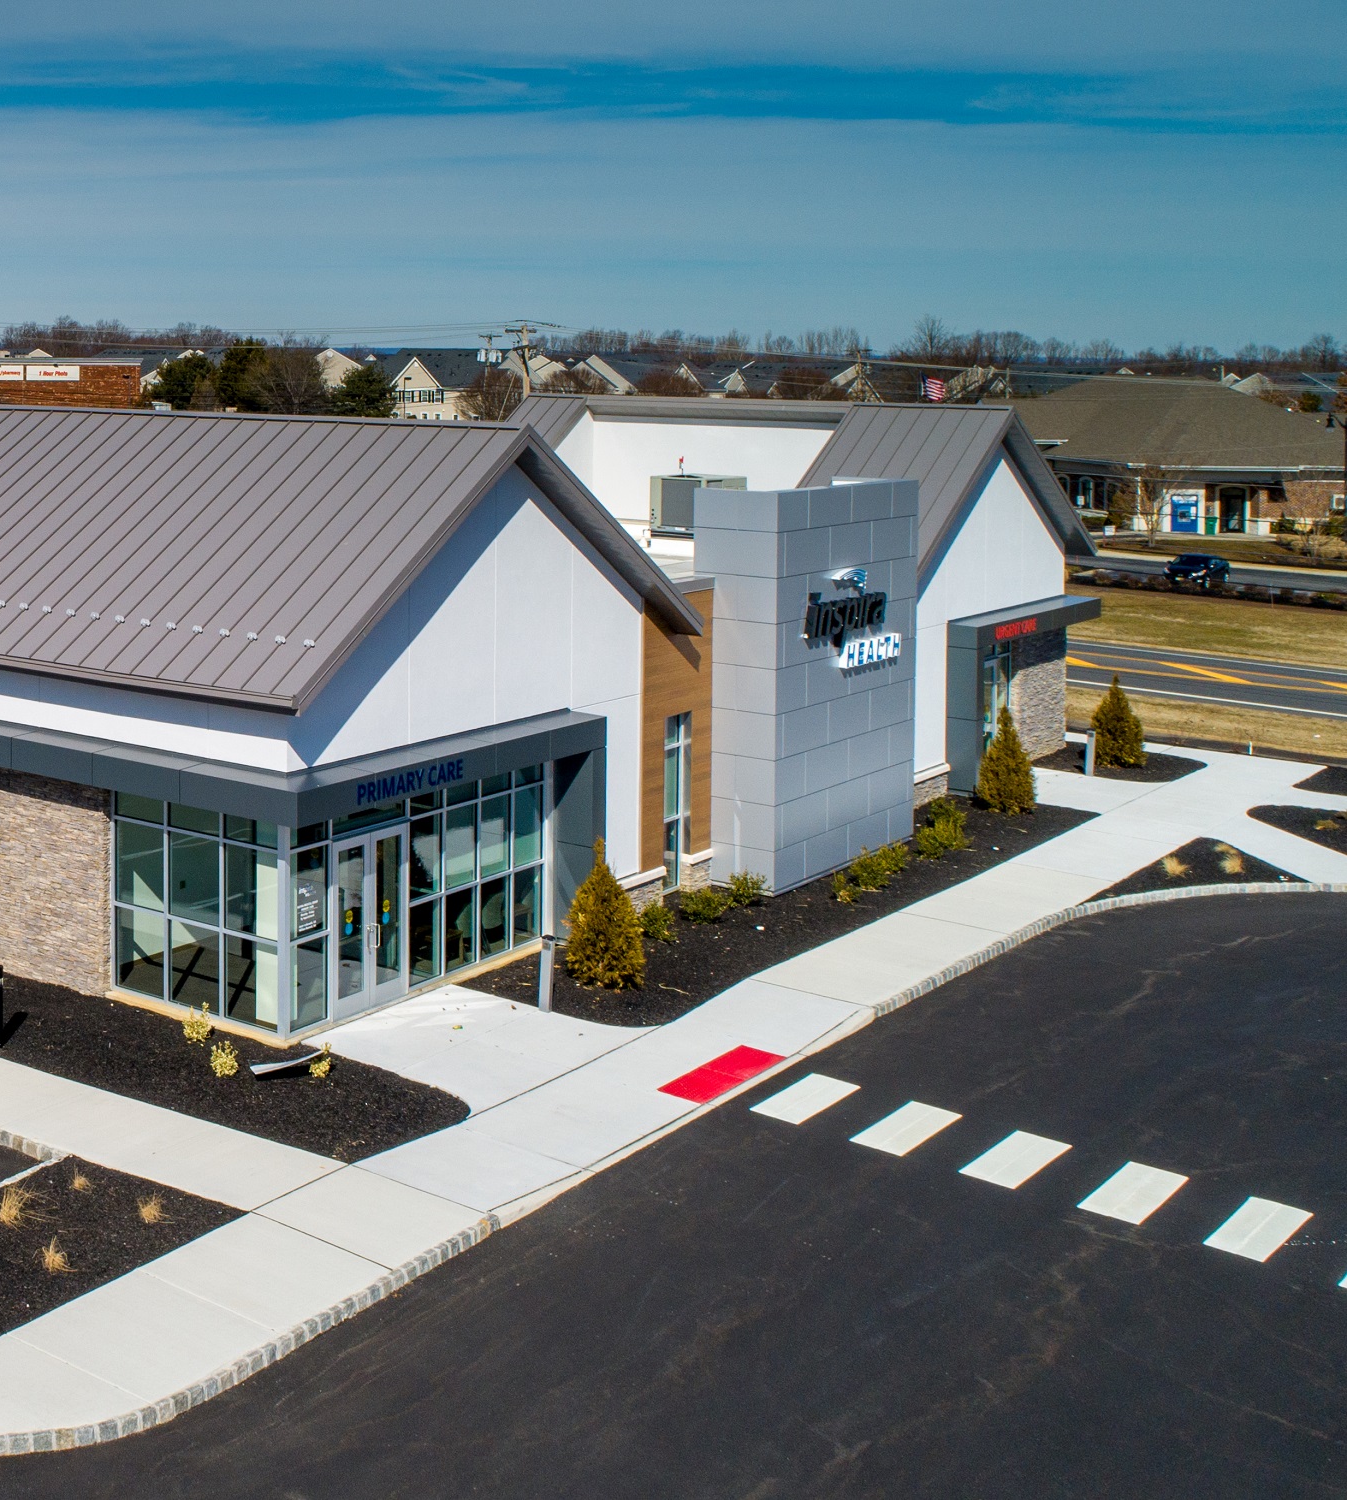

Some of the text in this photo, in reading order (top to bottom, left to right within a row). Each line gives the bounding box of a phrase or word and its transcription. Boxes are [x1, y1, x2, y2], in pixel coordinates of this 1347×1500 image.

[804, 592, 887, 648] inspira
[995, 617, 1037, 640] URGENT CARE
[841, 633, 901, 668] HEALTH
[357, 759, 464, 805] PRIMARY CARE
